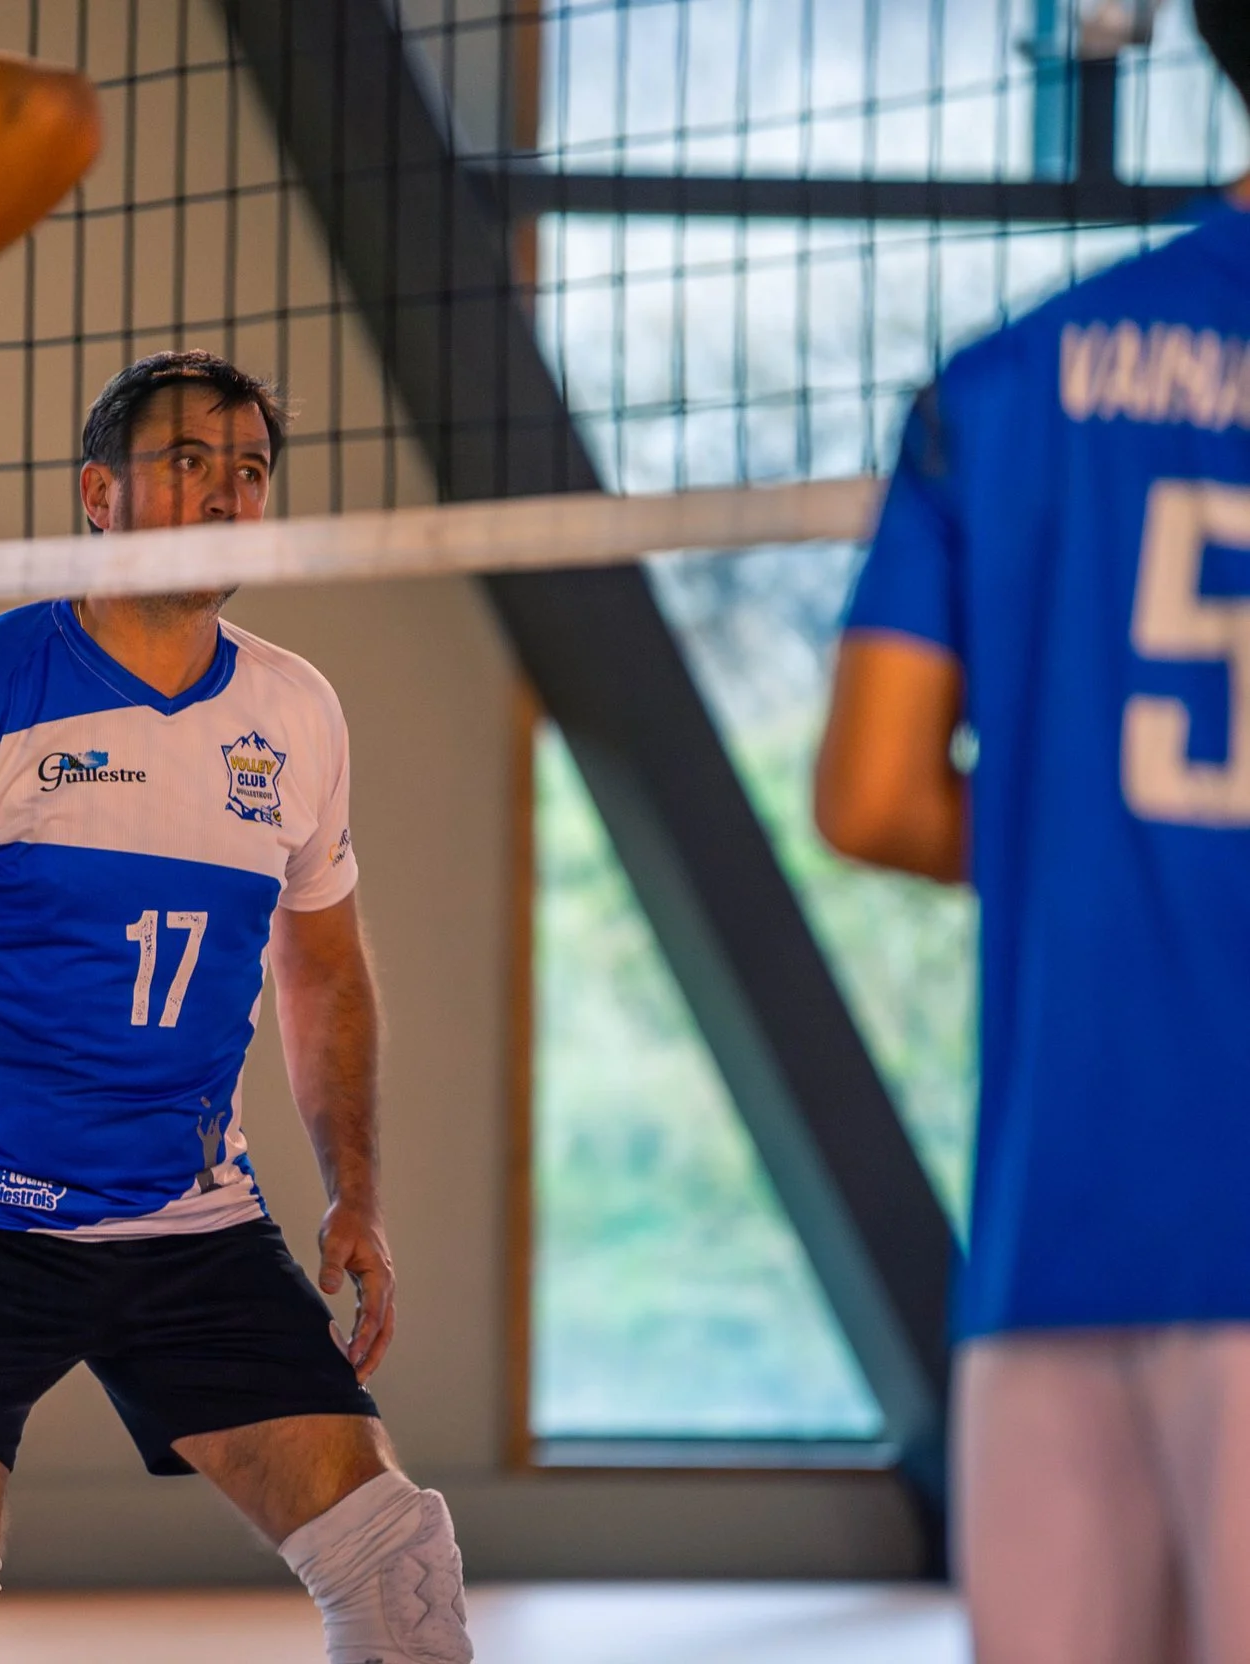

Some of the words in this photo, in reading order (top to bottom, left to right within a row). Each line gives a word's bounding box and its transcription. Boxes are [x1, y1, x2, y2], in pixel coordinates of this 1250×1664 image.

[1120, 477, 1250, 830] 5
[38, 752, 147, 793] Guillestre
[230, 755, 276, 775] VOLLEY
[237, 772, 267, 788] CLUB
[126, 910, 208, 1027] 17
